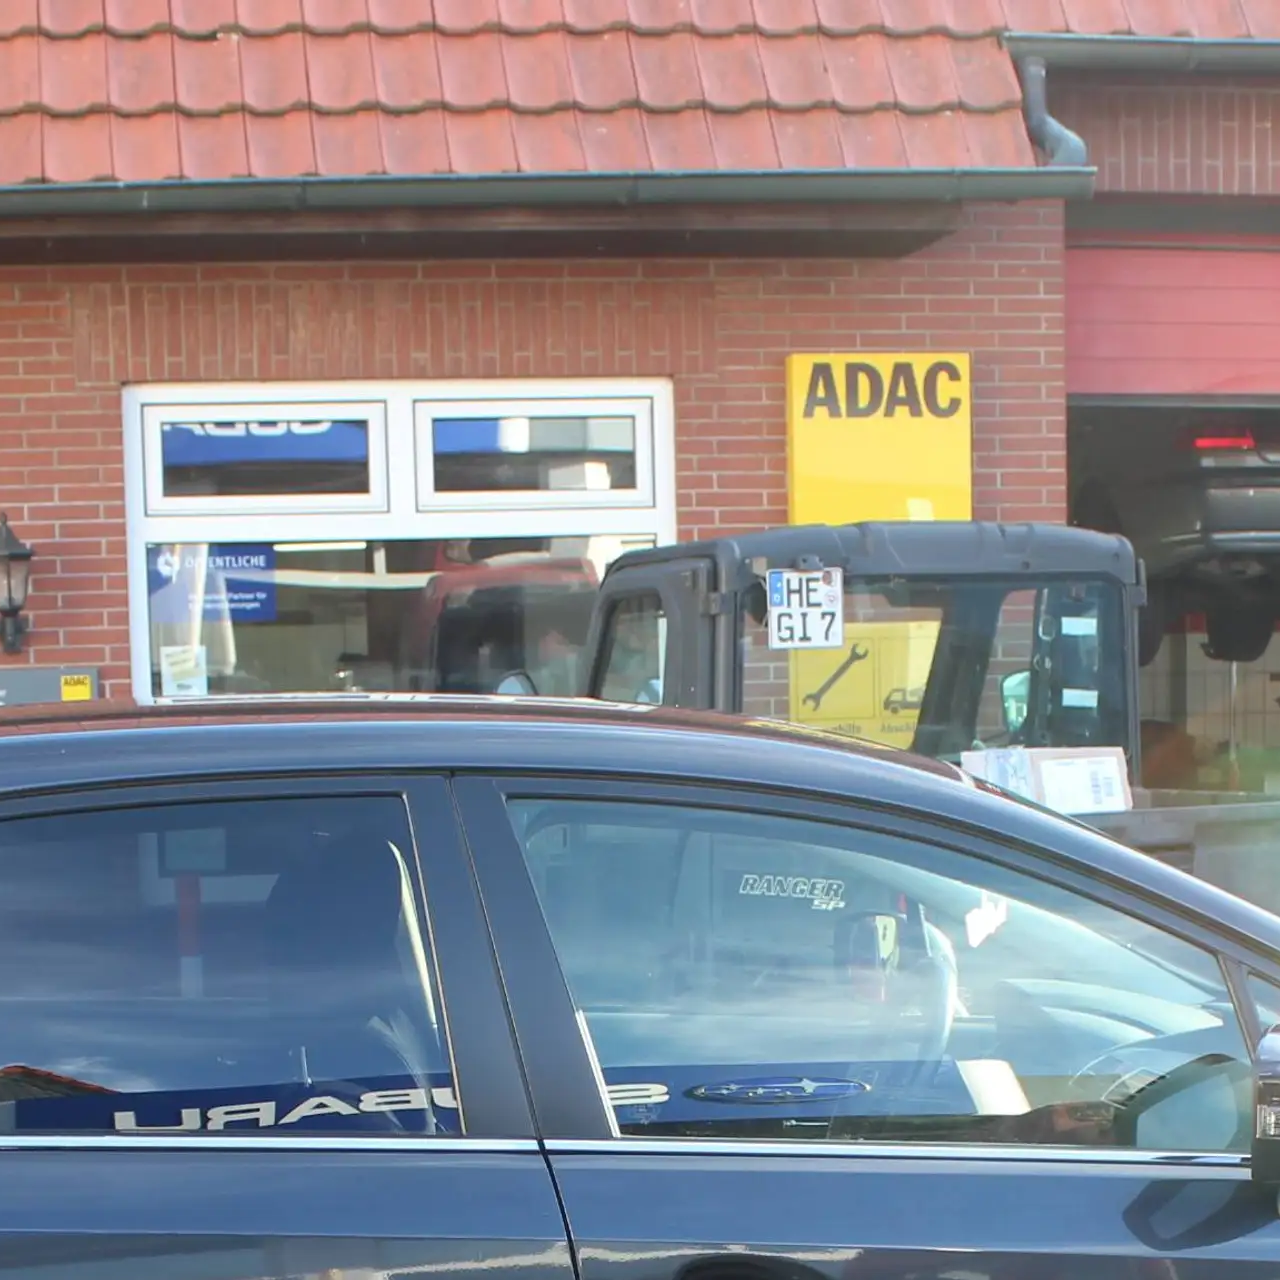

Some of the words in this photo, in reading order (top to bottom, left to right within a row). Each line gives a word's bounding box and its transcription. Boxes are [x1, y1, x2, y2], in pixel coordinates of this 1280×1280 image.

[802, 361, 962, 418] ADAC
[786, 577, 822, 608] HE
[777, 612, 812, 643] GI
[820, 611, 836, 642] 7
[64, 675, 89, 686] ADAC
[739, 875, 845, 900] RANGER
[811, 899, 845, 911] SP
